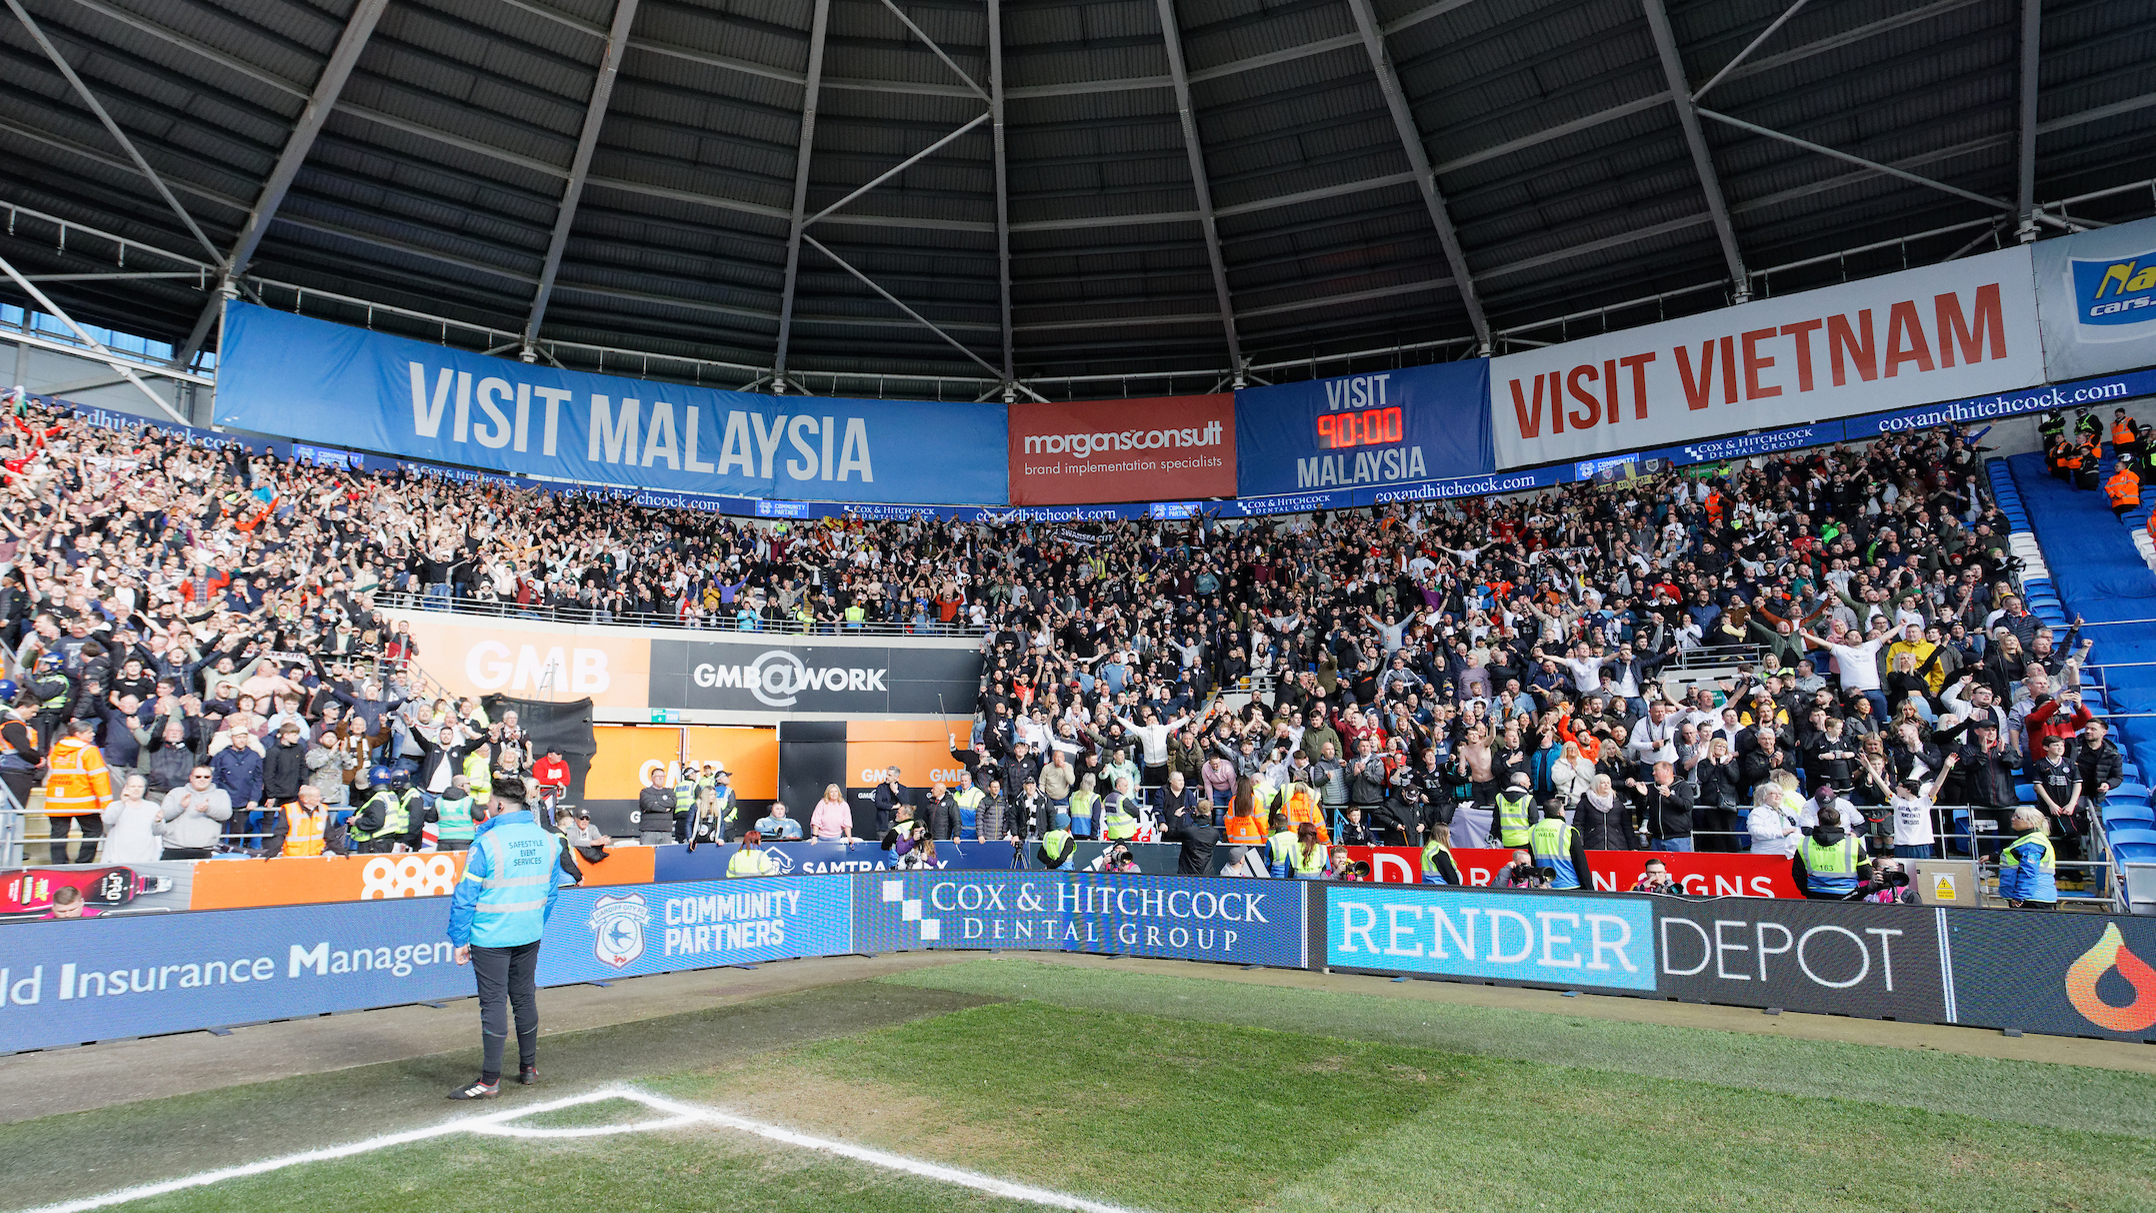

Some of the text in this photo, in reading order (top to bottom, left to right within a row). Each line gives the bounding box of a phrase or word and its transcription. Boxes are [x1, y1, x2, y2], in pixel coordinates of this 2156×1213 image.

[1509, 282, 2007, 440] VISIT VIETNAM
[1325, 373, 1390, 410] VISIT
[1878, 381, 2128, 432] coxandhitchcock.com
[408, 361, 874, 482] VISIT MALAYSIA
[1317, 406, 1403, 449] 90:00
[1024, 420, 1223, 458] morgansconsult
[1698, 428, 1813, 454] COX & HITCHCOCK
[1709, 438, 1804, 459] DENTAL GROUP
[317, 450, 359, 463] COMMUNTY
[1024, 454, 1223, 476] brand implementation specialists
[1297, 446, 1427, 488] MALAYSIA
[1597, 456, 1636, 468] COMMUNITY
[1374, 474, 1536, 502] coxandhitchcock.com
[774, 502, 806, 510] COMMUNITY
[774, 508, 798, 516] PARTNER
[874, 506, 881, 514] &
[883, 506, 935, 515] HITCHCOCK
[976, 508, 1116, 522] codhitchcock.com
[1248, 500, 1266, 509] COX
[1278, 495, 1330, 506] HITCHCOCK
[1256, 506, 1289, 514] DENTAL
[1061, 527, 1115, 542] SWANSEA CITY
[465, 640, 611, 694] GMB
[694, 650, 888, 707] GMB@WORK
[861, 768, 887, 783] GM
[509, 840, 544, 849] SAFESTYLE
[520, 849, 536, 857] EVENT
[514, 857, 542, 866] SERVICES
[1819, 864, 1834, 872] 163
[360, 855, 456, 900] 888
[1637, 872, 1776, 899] GNS
[665, 889, 801, 926] COMMUNITY
[931, 882, 1270, 924] COX & HITCHCOCK
[665, 919, 785, 956] PARTNERS
[963, 917, 1239, 952] DENTAL GROUP
[1336, 901, 1638, 973] RENDER
[1659, 916, 1903, 992] DEPOT
[59, 955, 274, 1000] Insurance
